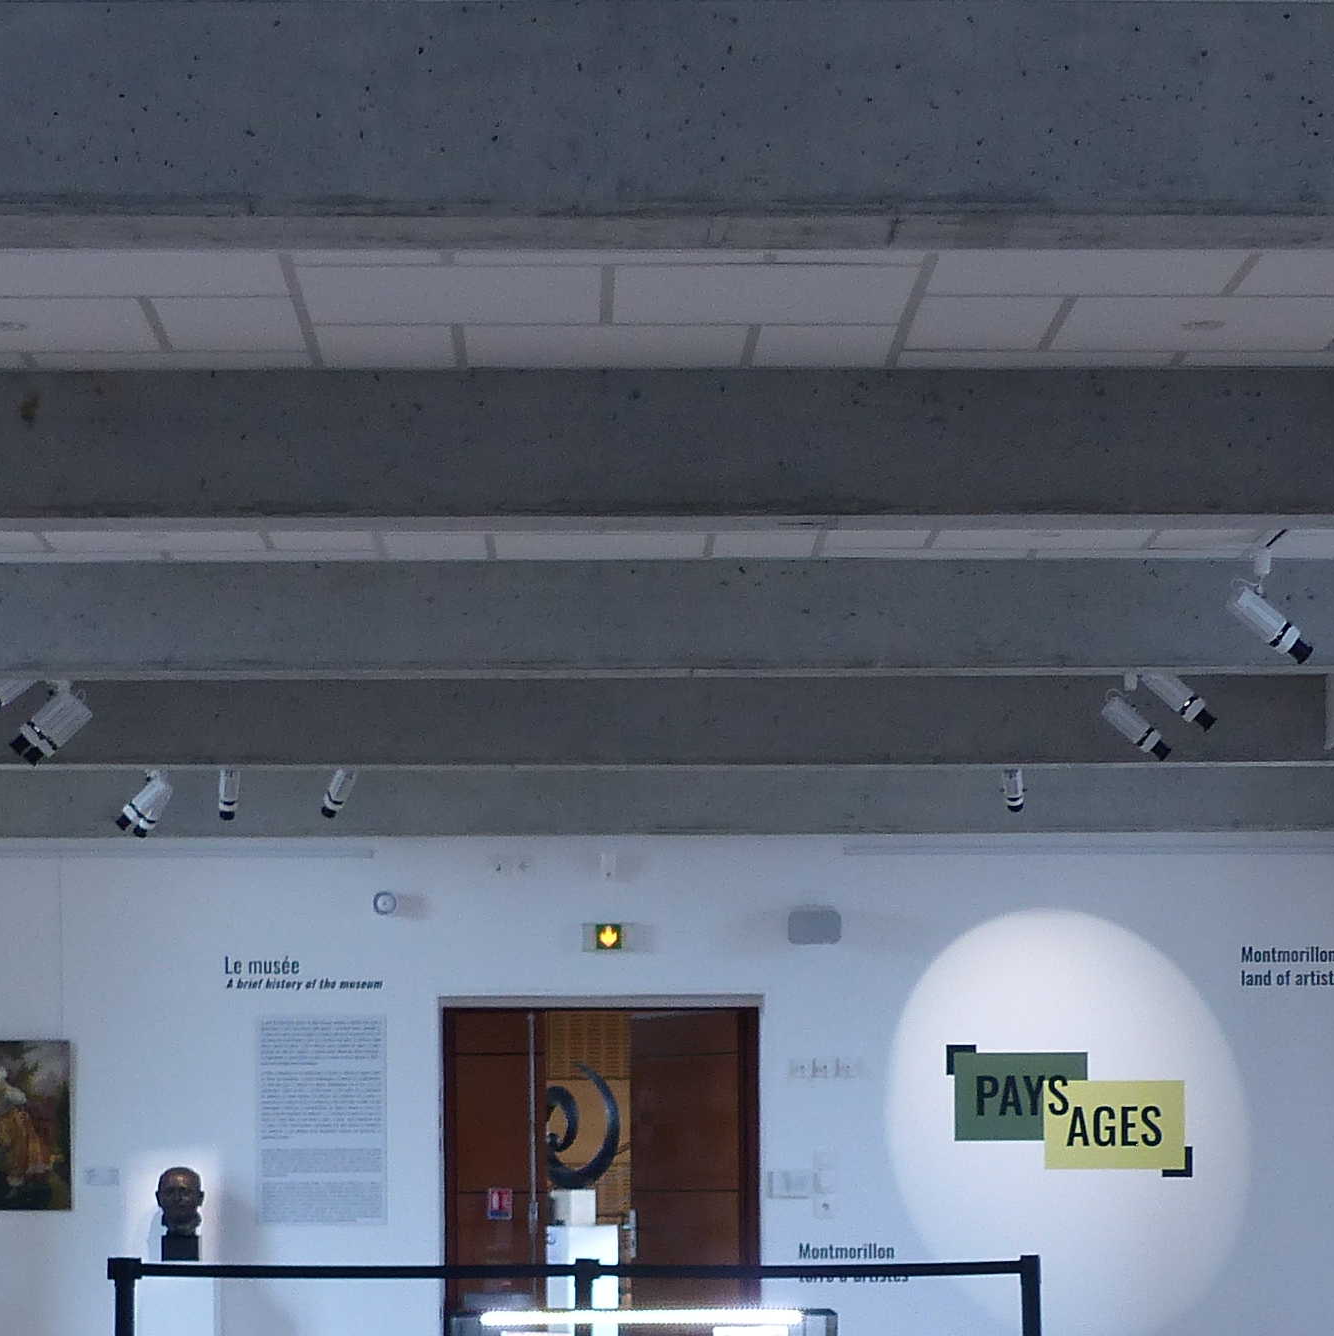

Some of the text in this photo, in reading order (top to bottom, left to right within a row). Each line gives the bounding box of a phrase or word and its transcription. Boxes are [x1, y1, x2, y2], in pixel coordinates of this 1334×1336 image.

[224, 956, 300, 975] Le musée
[226, 978, 383, 991] A brief history of the museum
[1241, 970, 1272, 986] land
[1276, 970, 1291, 986] of
[975, 1074, 1070, 1117] PAYS
[1066, 1105, 1164, 1147] AGES
[798, 1243, 895, 1260] Montmorillon
